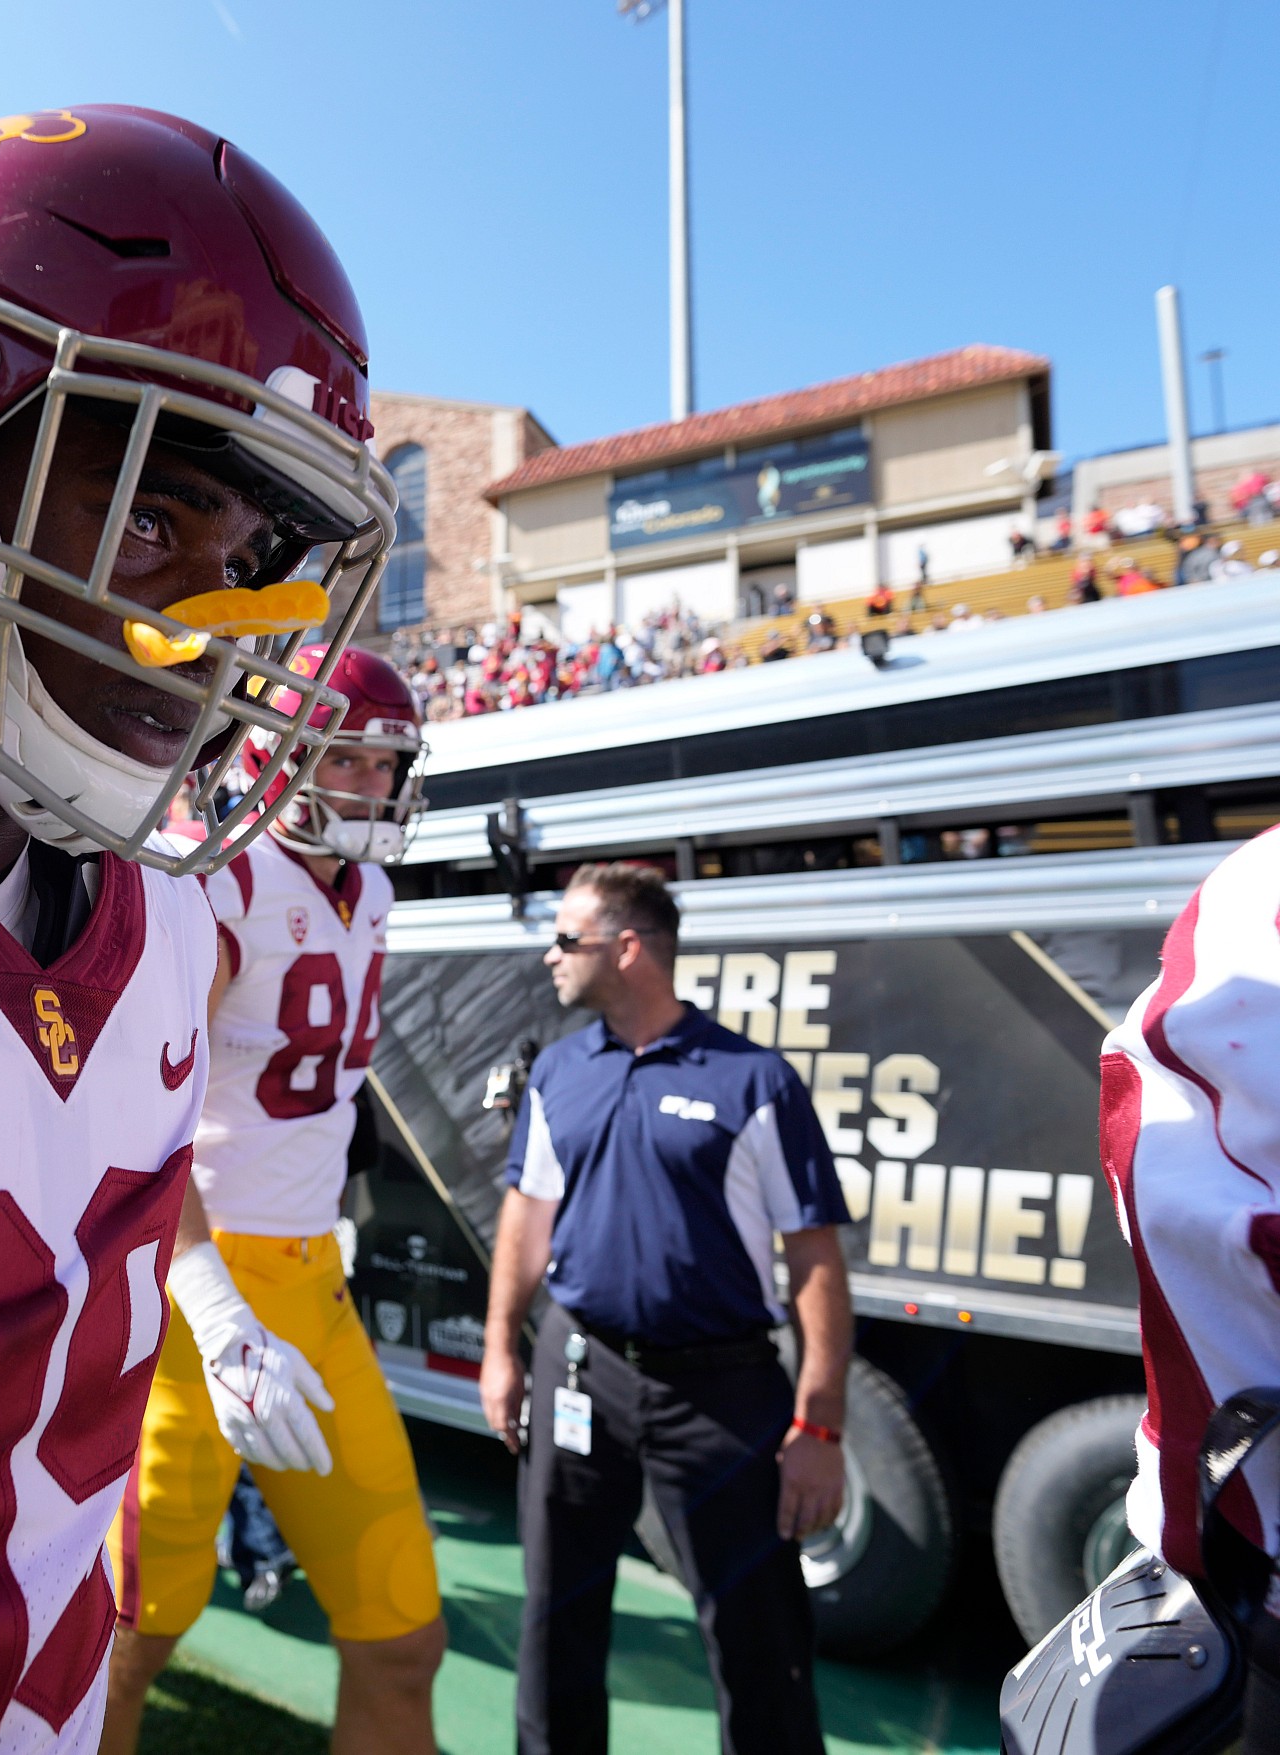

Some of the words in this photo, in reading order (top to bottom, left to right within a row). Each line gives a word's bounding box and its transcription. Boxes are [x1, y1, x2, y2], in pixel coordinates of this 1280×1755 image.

[34, 989, 79, 1076] SC
[256, 952, 386, 1119] 84
[783, 1052, 941, 1160] ES
